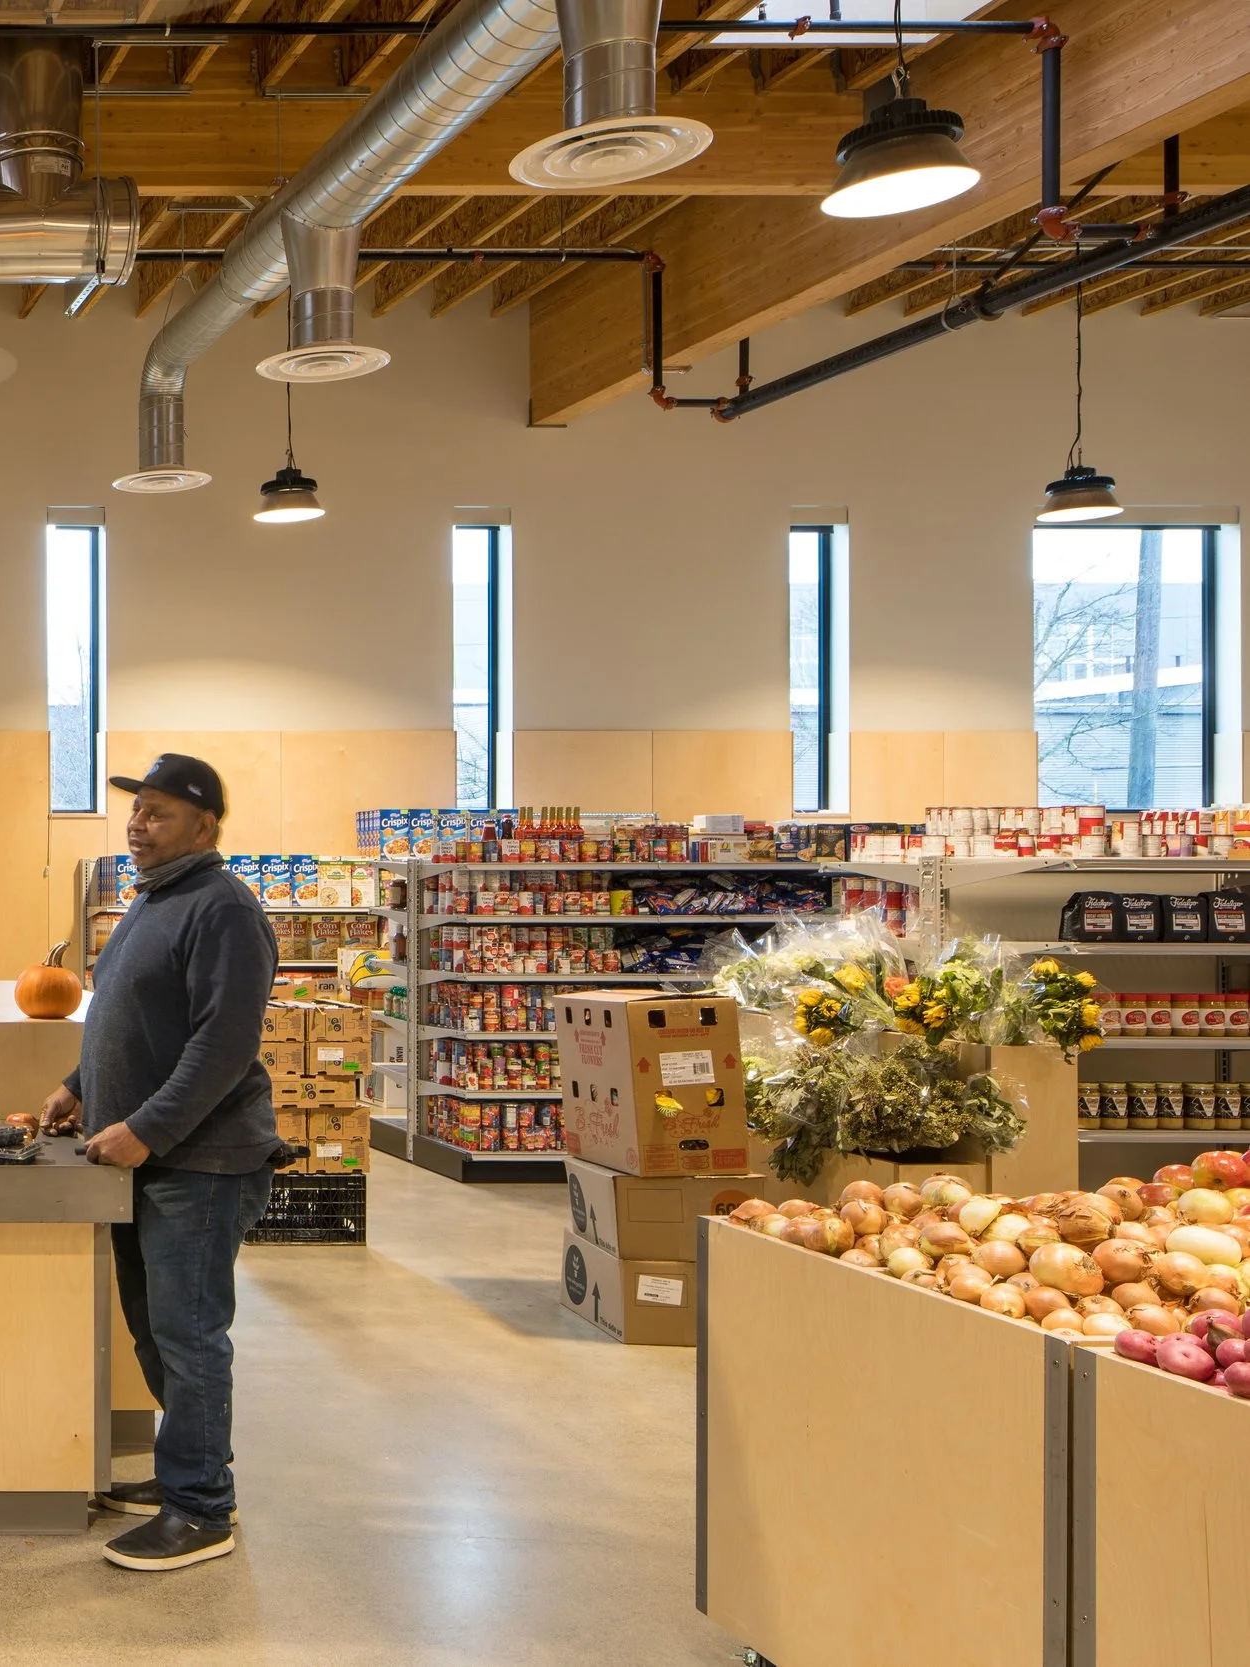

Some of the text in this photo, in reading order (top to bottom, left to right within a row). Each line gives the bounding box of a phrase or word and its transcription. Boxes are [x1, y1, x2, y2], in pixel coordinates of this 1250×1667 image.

[381, 816, 408, 828] Crispix
[411, 817, 432, 828] Crisp
[117, 862, 137, 874] Crisp
[232, 862, 259, 873] Crispix
[262, 862, 289, 873] Crispix
[293, 862, 318, 873] Crispix
[316, 928, 340, 936] Flakes
[349, 928, 374, 936] Flakes
[599, 1316, 623, 1337] This side up
